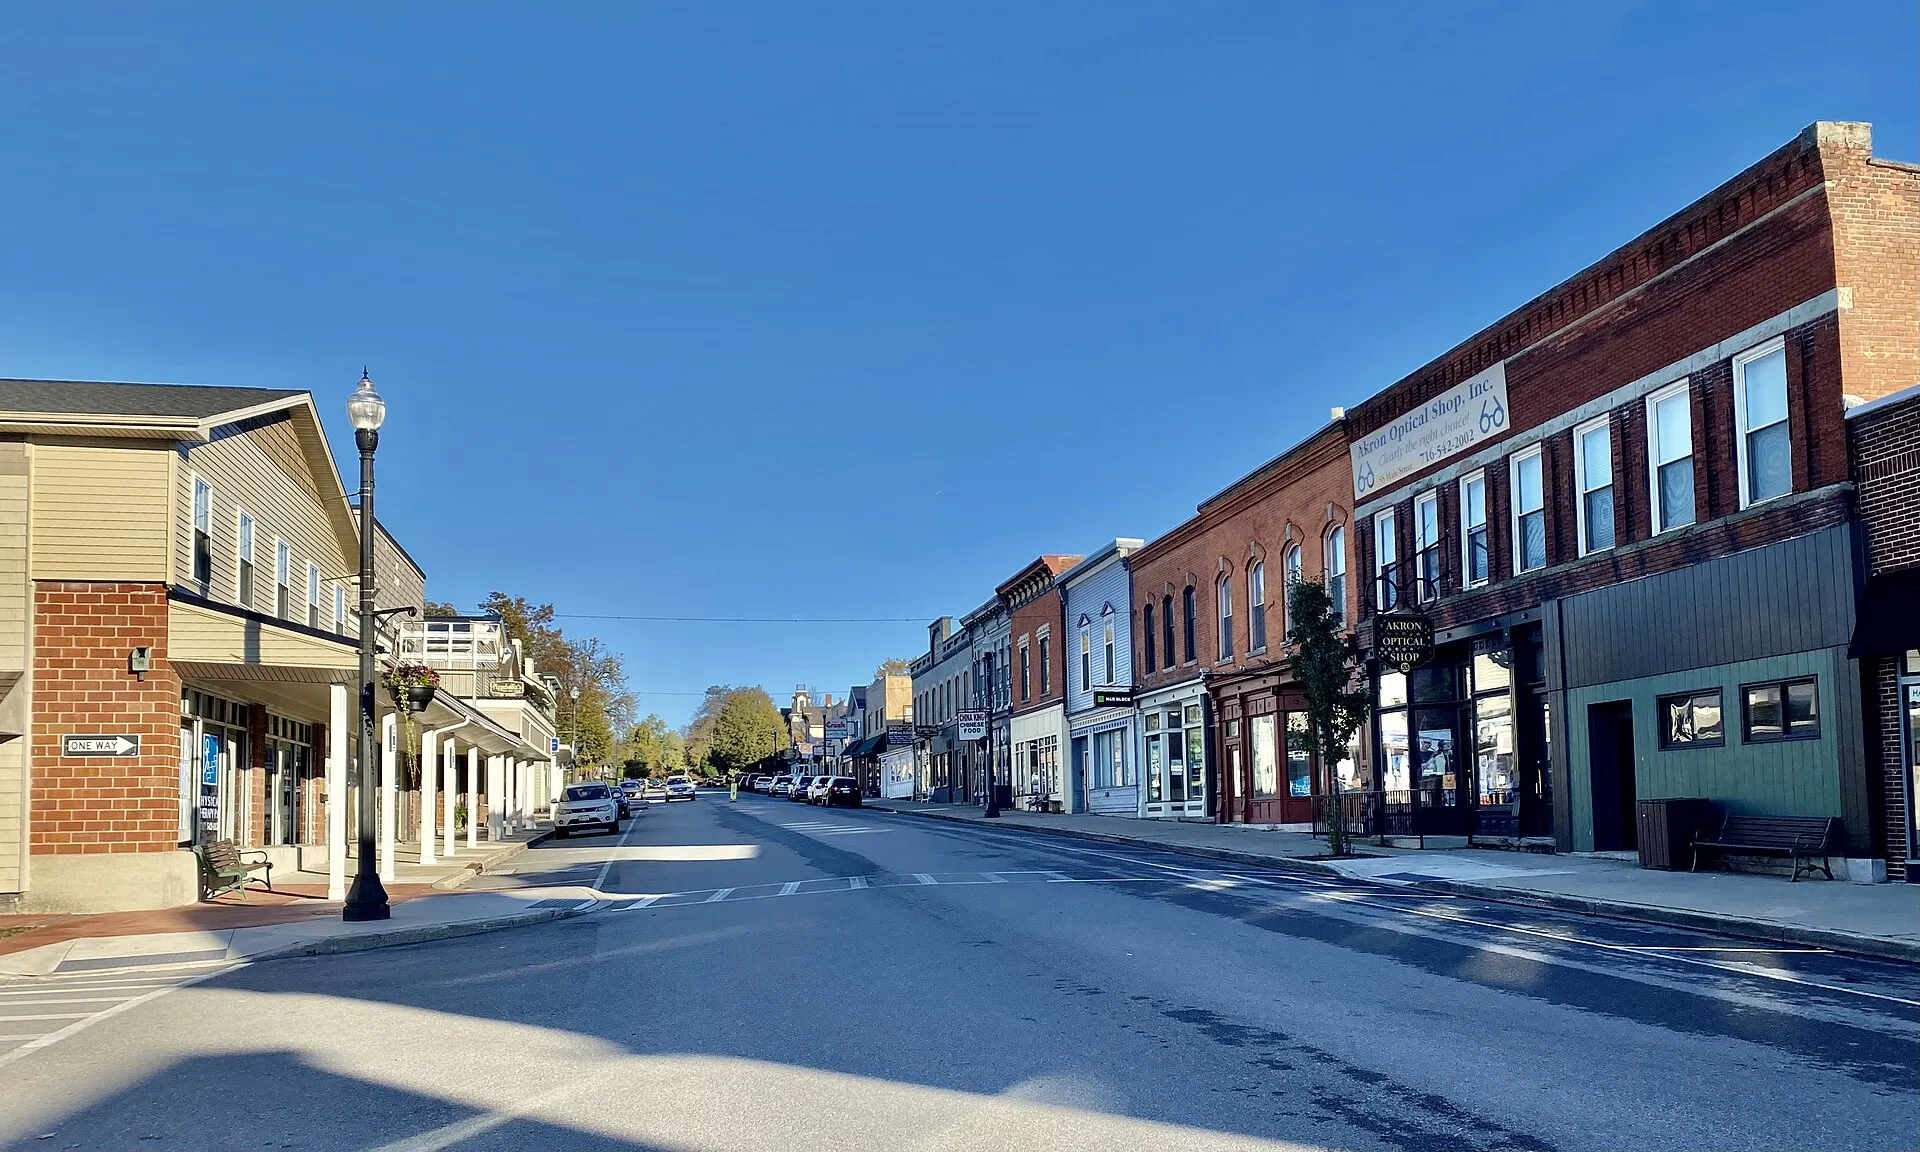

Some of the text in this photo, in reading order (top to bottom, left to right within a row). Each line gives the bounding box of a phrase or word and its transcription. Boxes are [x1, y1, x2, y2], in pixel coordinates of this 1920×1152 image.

[1358, 379, 1493, 459] Akron Optical Shop, Inc.
[1405, 439, 1418, 454] the
[1419, 429, 1438, 447] right
[1440, 409, 1470, 437] choice!
[1420, 429, 1475, 464] 716-542-2002
[1386, 622, 1422, 630] AKRON
[1382, 637, 1425, 646] OPTICAL
[1390, 652, 1419, 661] SHOP
[71, 741, 118, 750] ONE WAY
